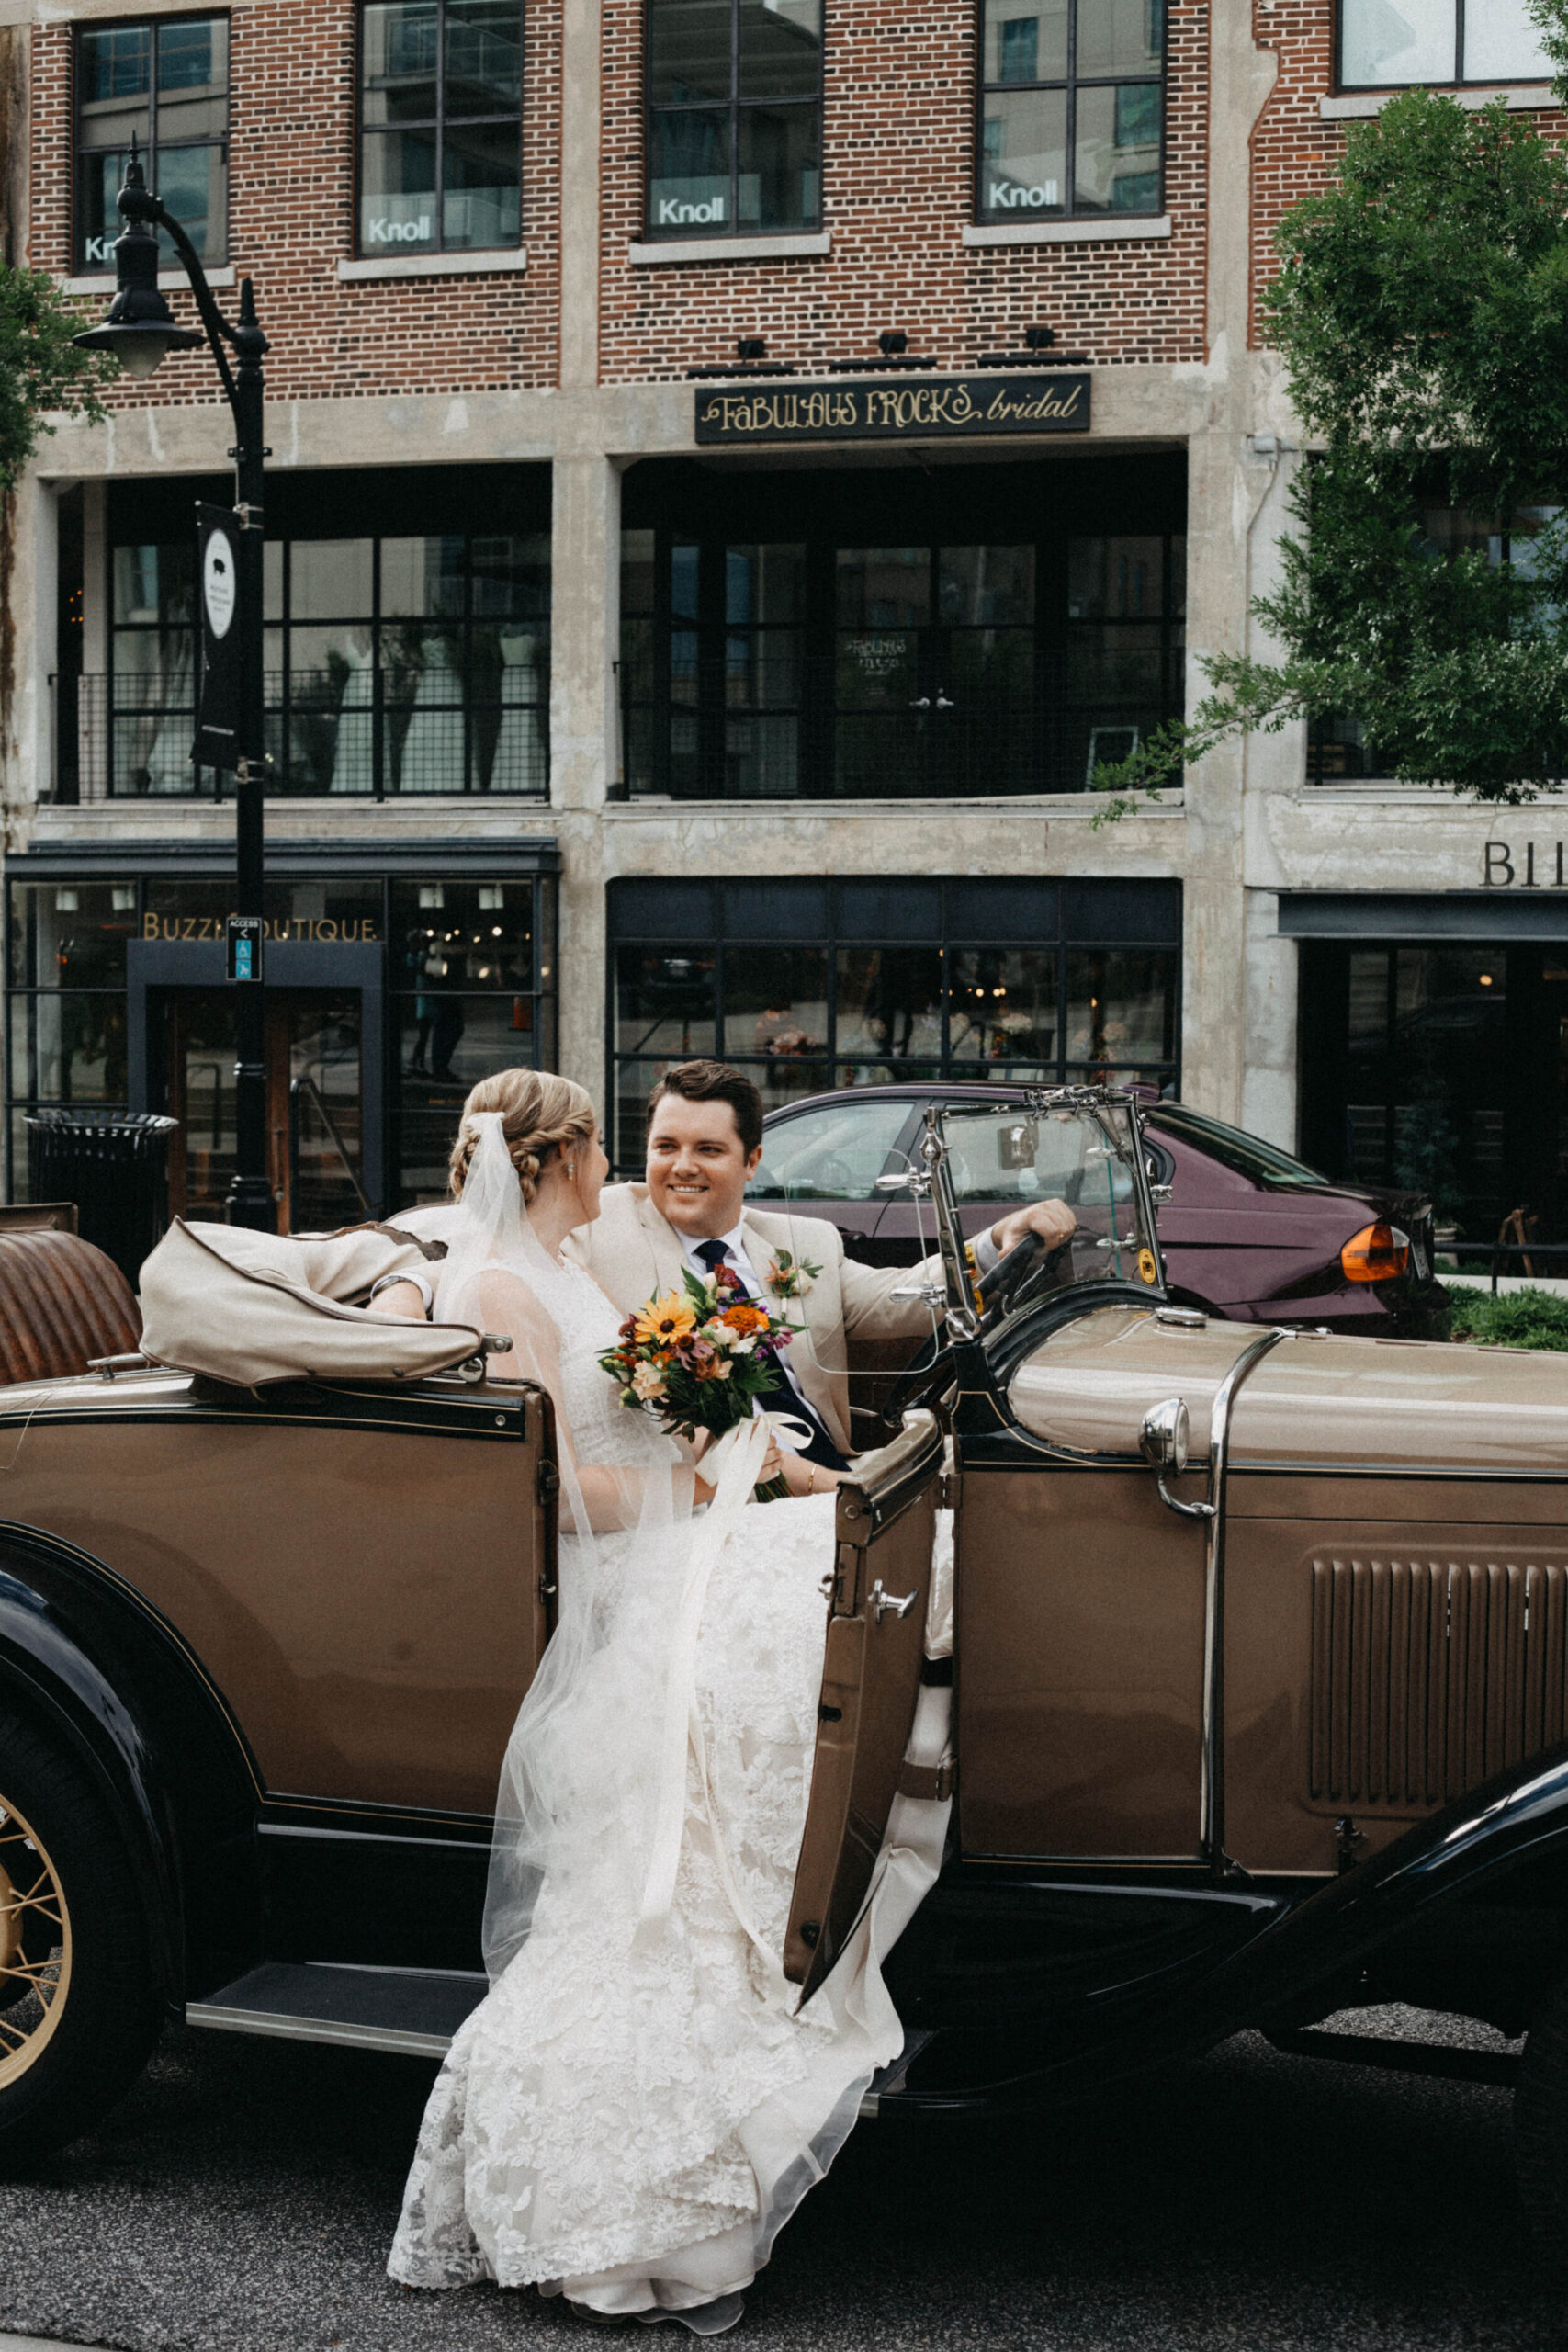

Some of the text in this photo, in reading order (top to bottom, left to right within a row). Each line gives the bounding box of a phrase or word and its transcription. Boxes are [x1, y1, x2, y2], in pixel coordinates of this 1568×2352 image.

[989, 180, 1057, 209] Knoll
[660, 196, 724, 225] Knoll
[368, 215, 430, 243] Knoll
[865, 384, 982, 428] FROCKS
[987, 384, 1082, 421] bridal
[230, 920, 259, 929] ACCESS
